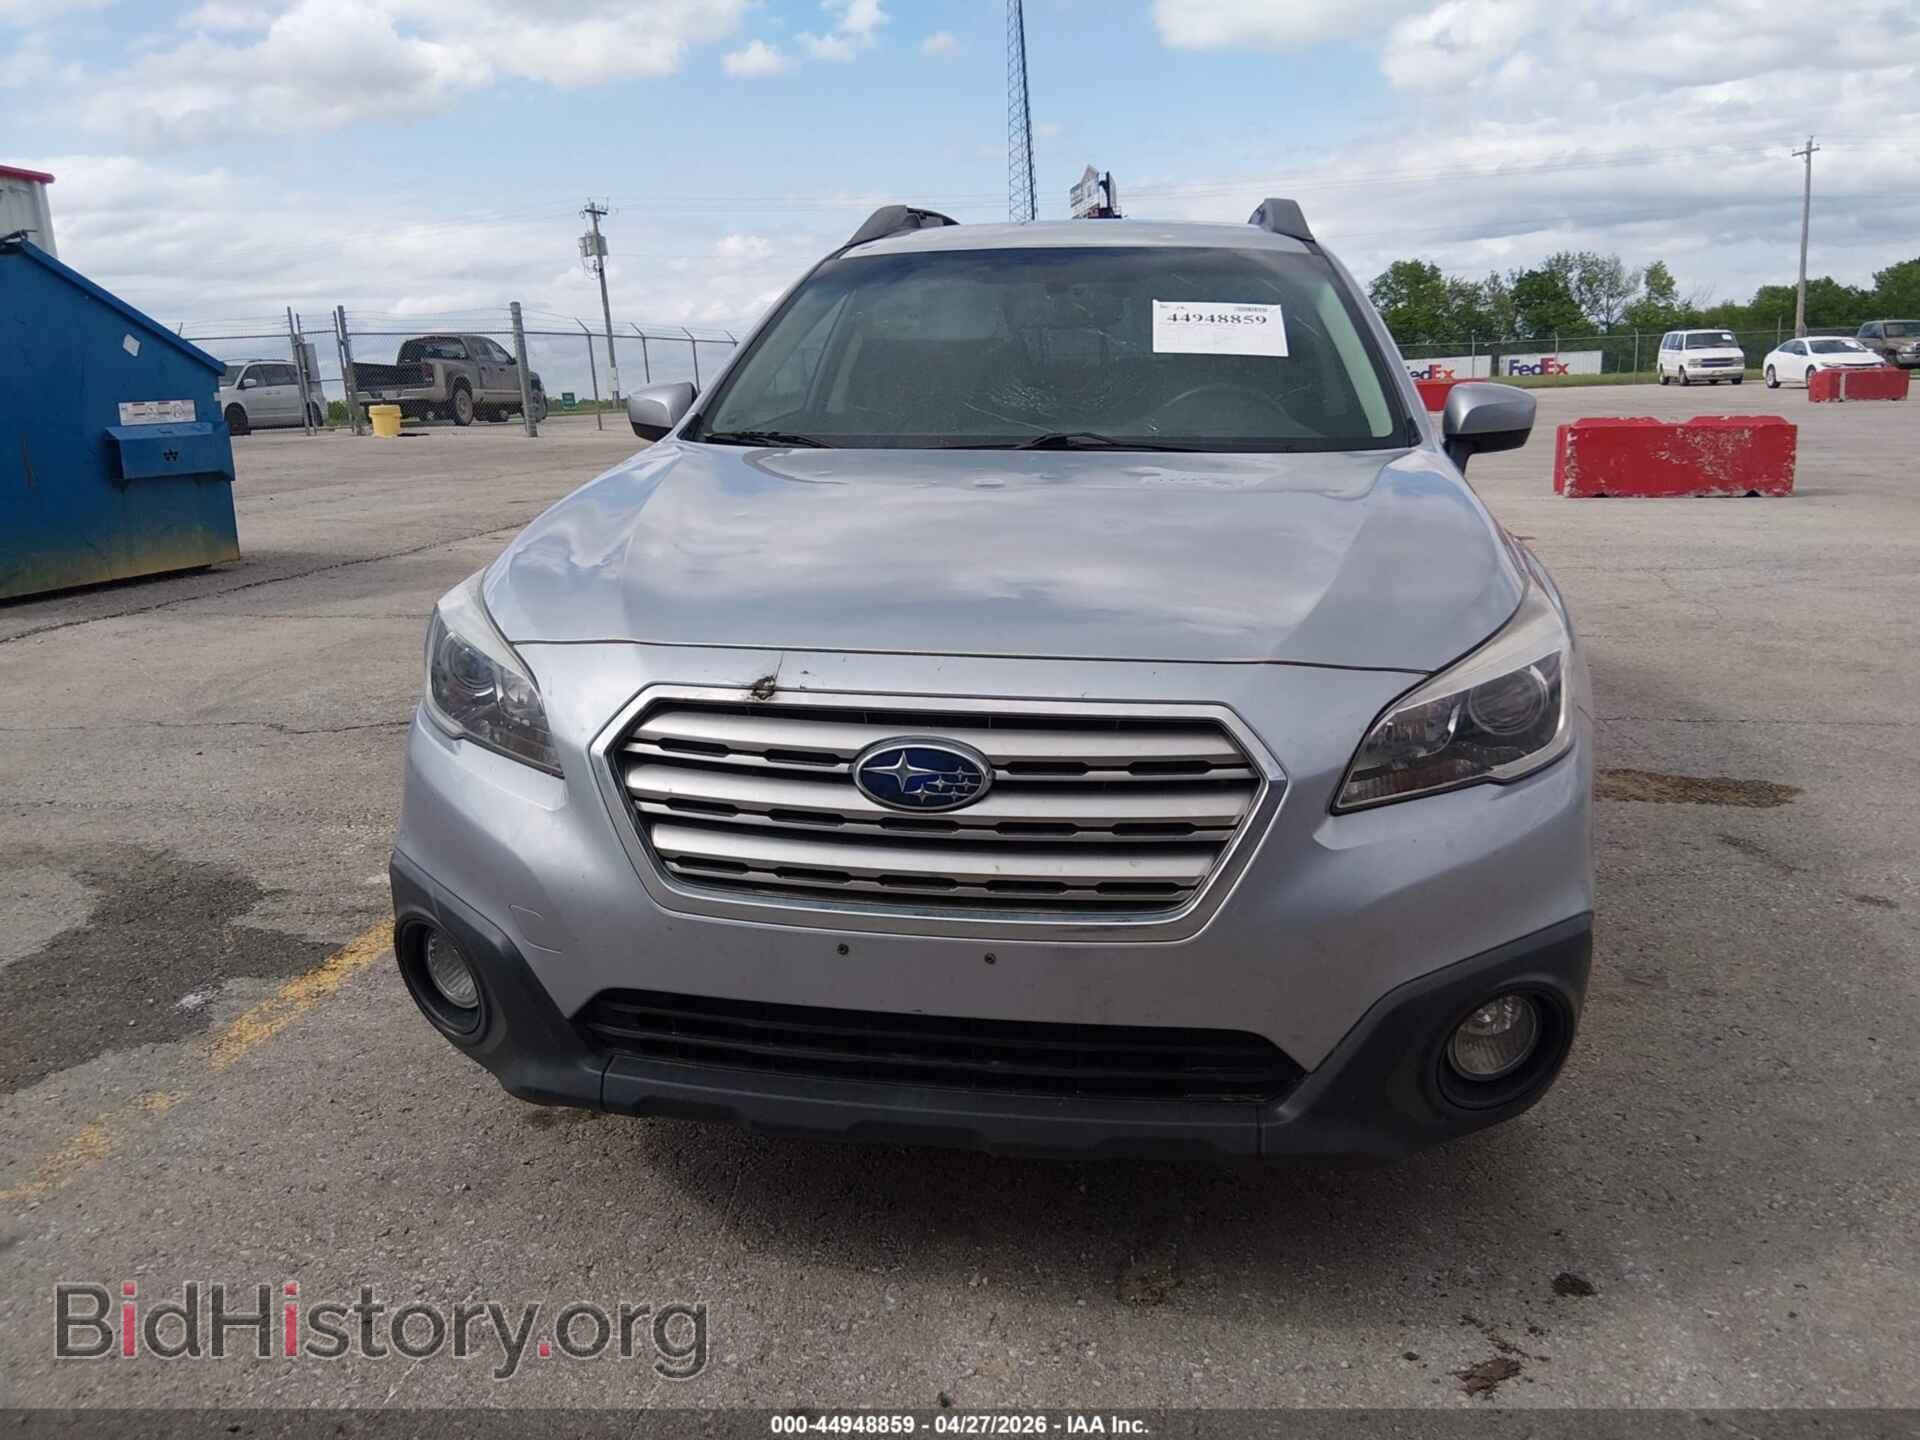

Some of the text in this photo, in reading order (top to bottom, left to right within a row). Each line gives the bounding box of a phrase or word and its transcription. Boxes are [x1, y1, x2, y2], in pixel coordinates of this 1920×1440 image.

[1167, 313, 1267, 324] 44948859
[1406, 364, 1455, 380] edEx
[1509, 358, 1569, 376] FedEx
